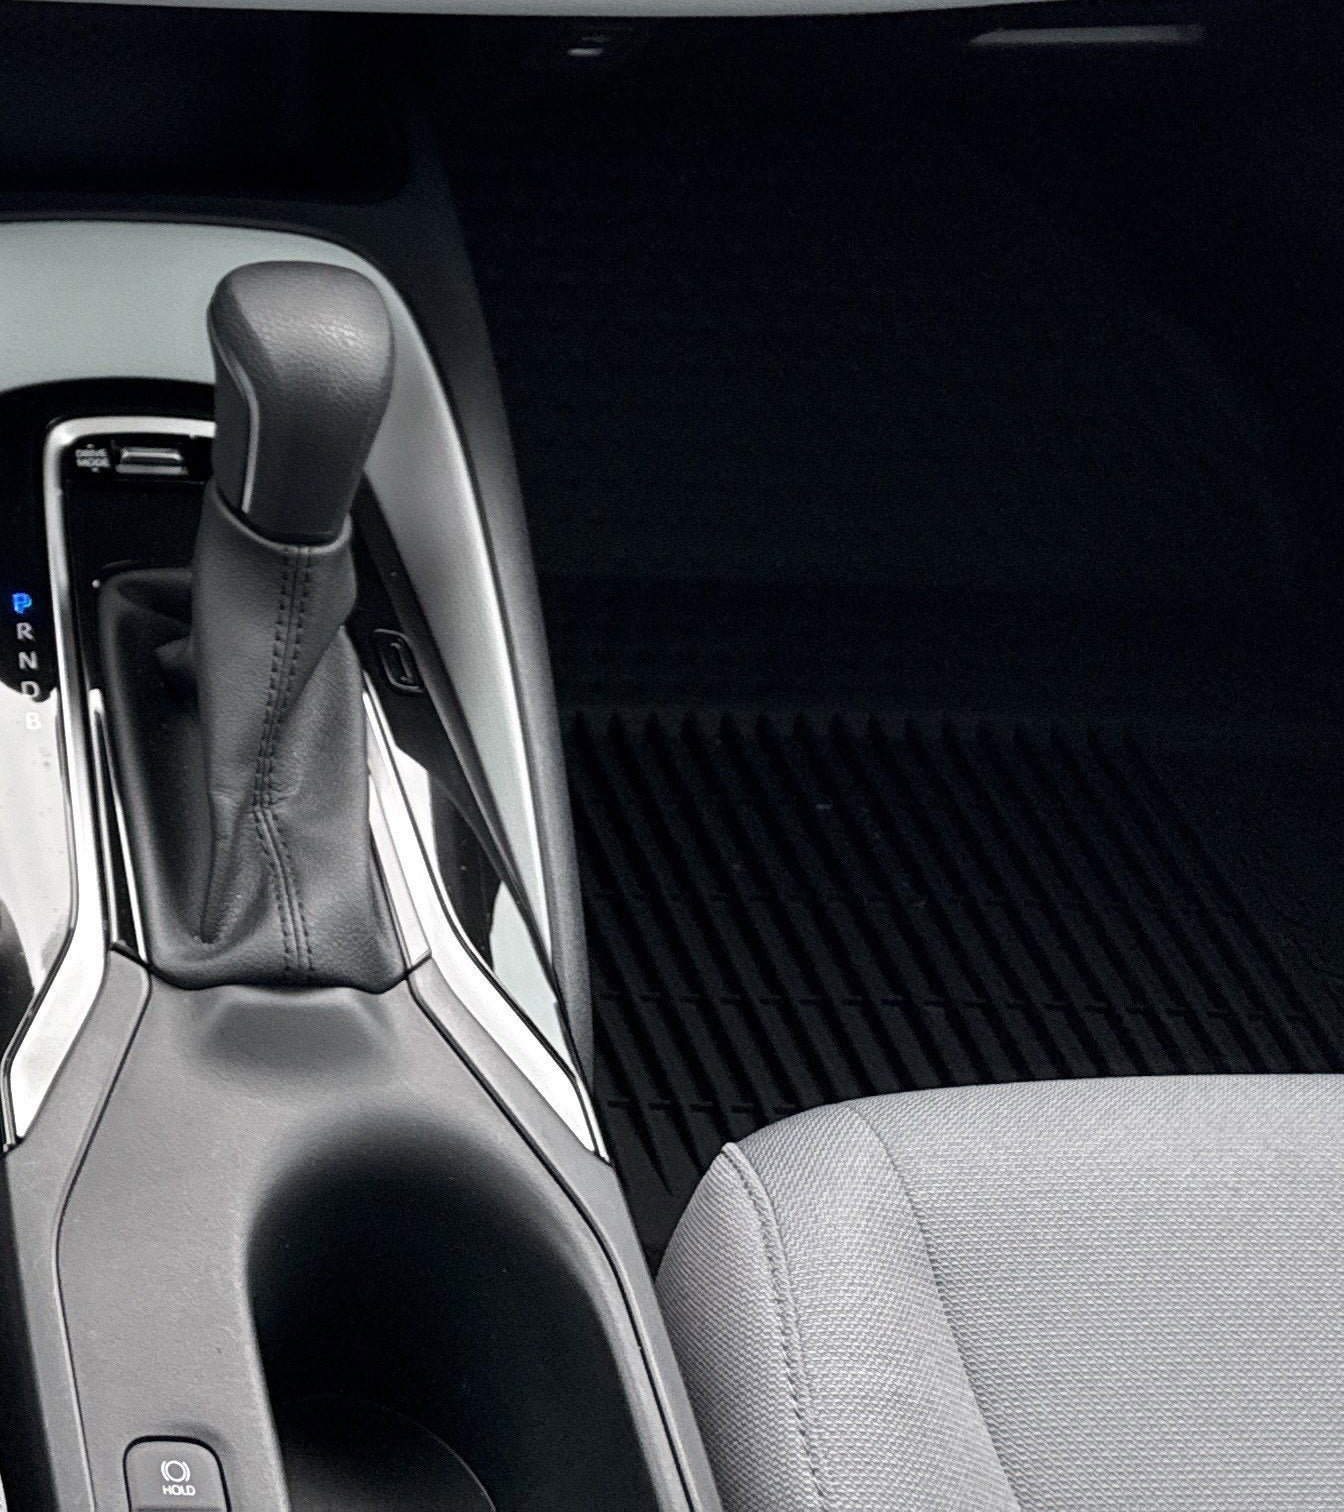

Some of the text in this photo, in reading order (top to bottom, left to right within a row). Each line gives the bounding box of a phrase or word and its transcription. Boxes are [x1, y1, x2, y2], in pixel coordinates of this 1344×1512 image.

[12, 593, 33, 614] P
[16, 622, 34, 640] R
[18, 651, 39, 669] N
[21, 680, 40, 699] D
[25, 711, 42, 730] B
[163, 1484, 196, 1496] HOLD
